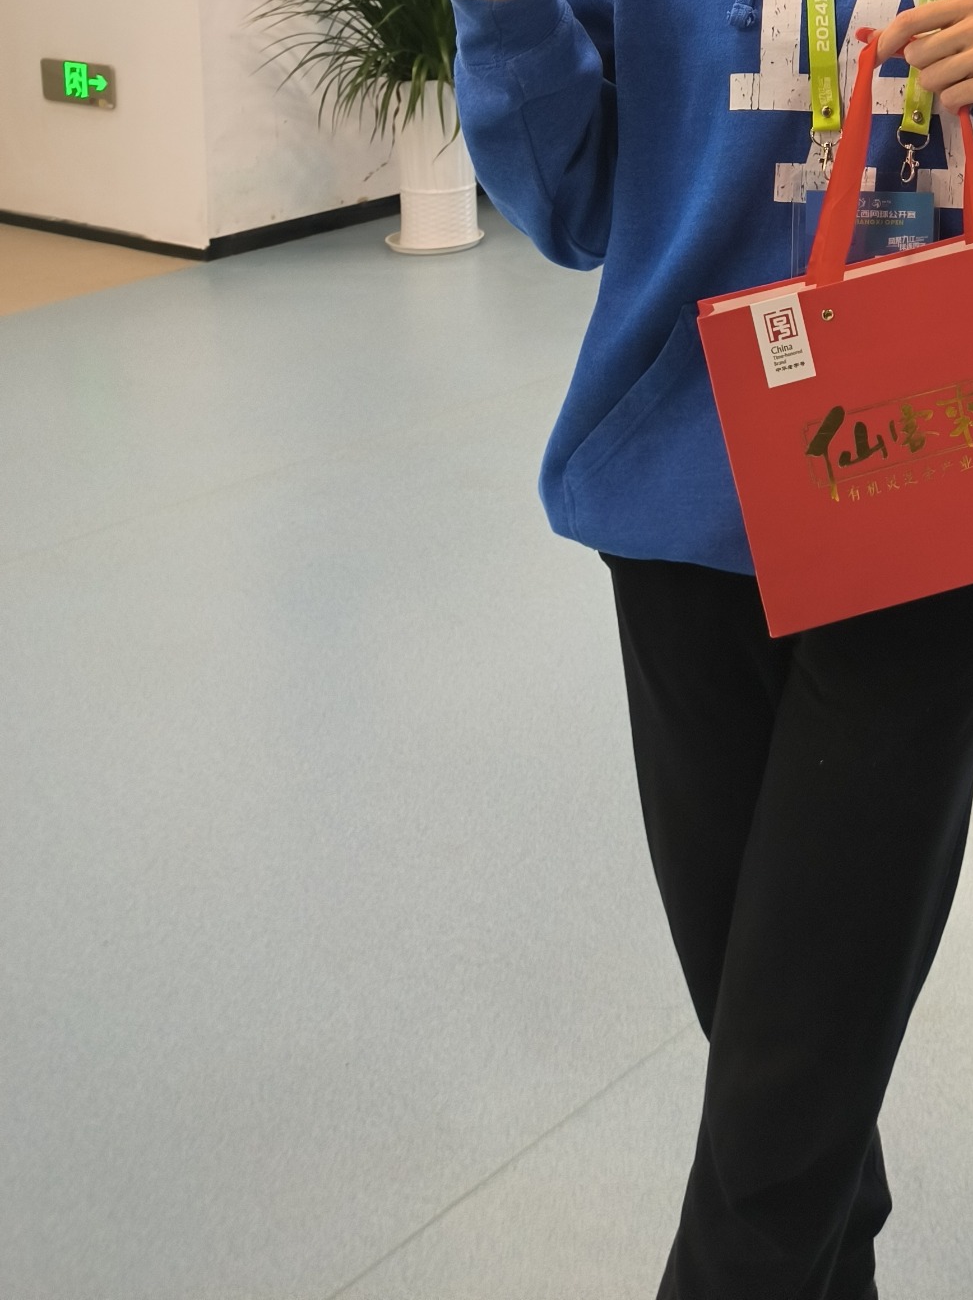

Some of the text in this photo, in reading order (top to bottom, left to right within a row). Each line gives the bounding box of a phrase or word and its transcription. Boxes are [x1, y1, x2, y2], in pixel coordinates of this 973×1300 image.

[856, 209, 916, 219] 西网球公开赛
[770, 344, 793, 355] China
[773, 359, 787, 367] Brand
